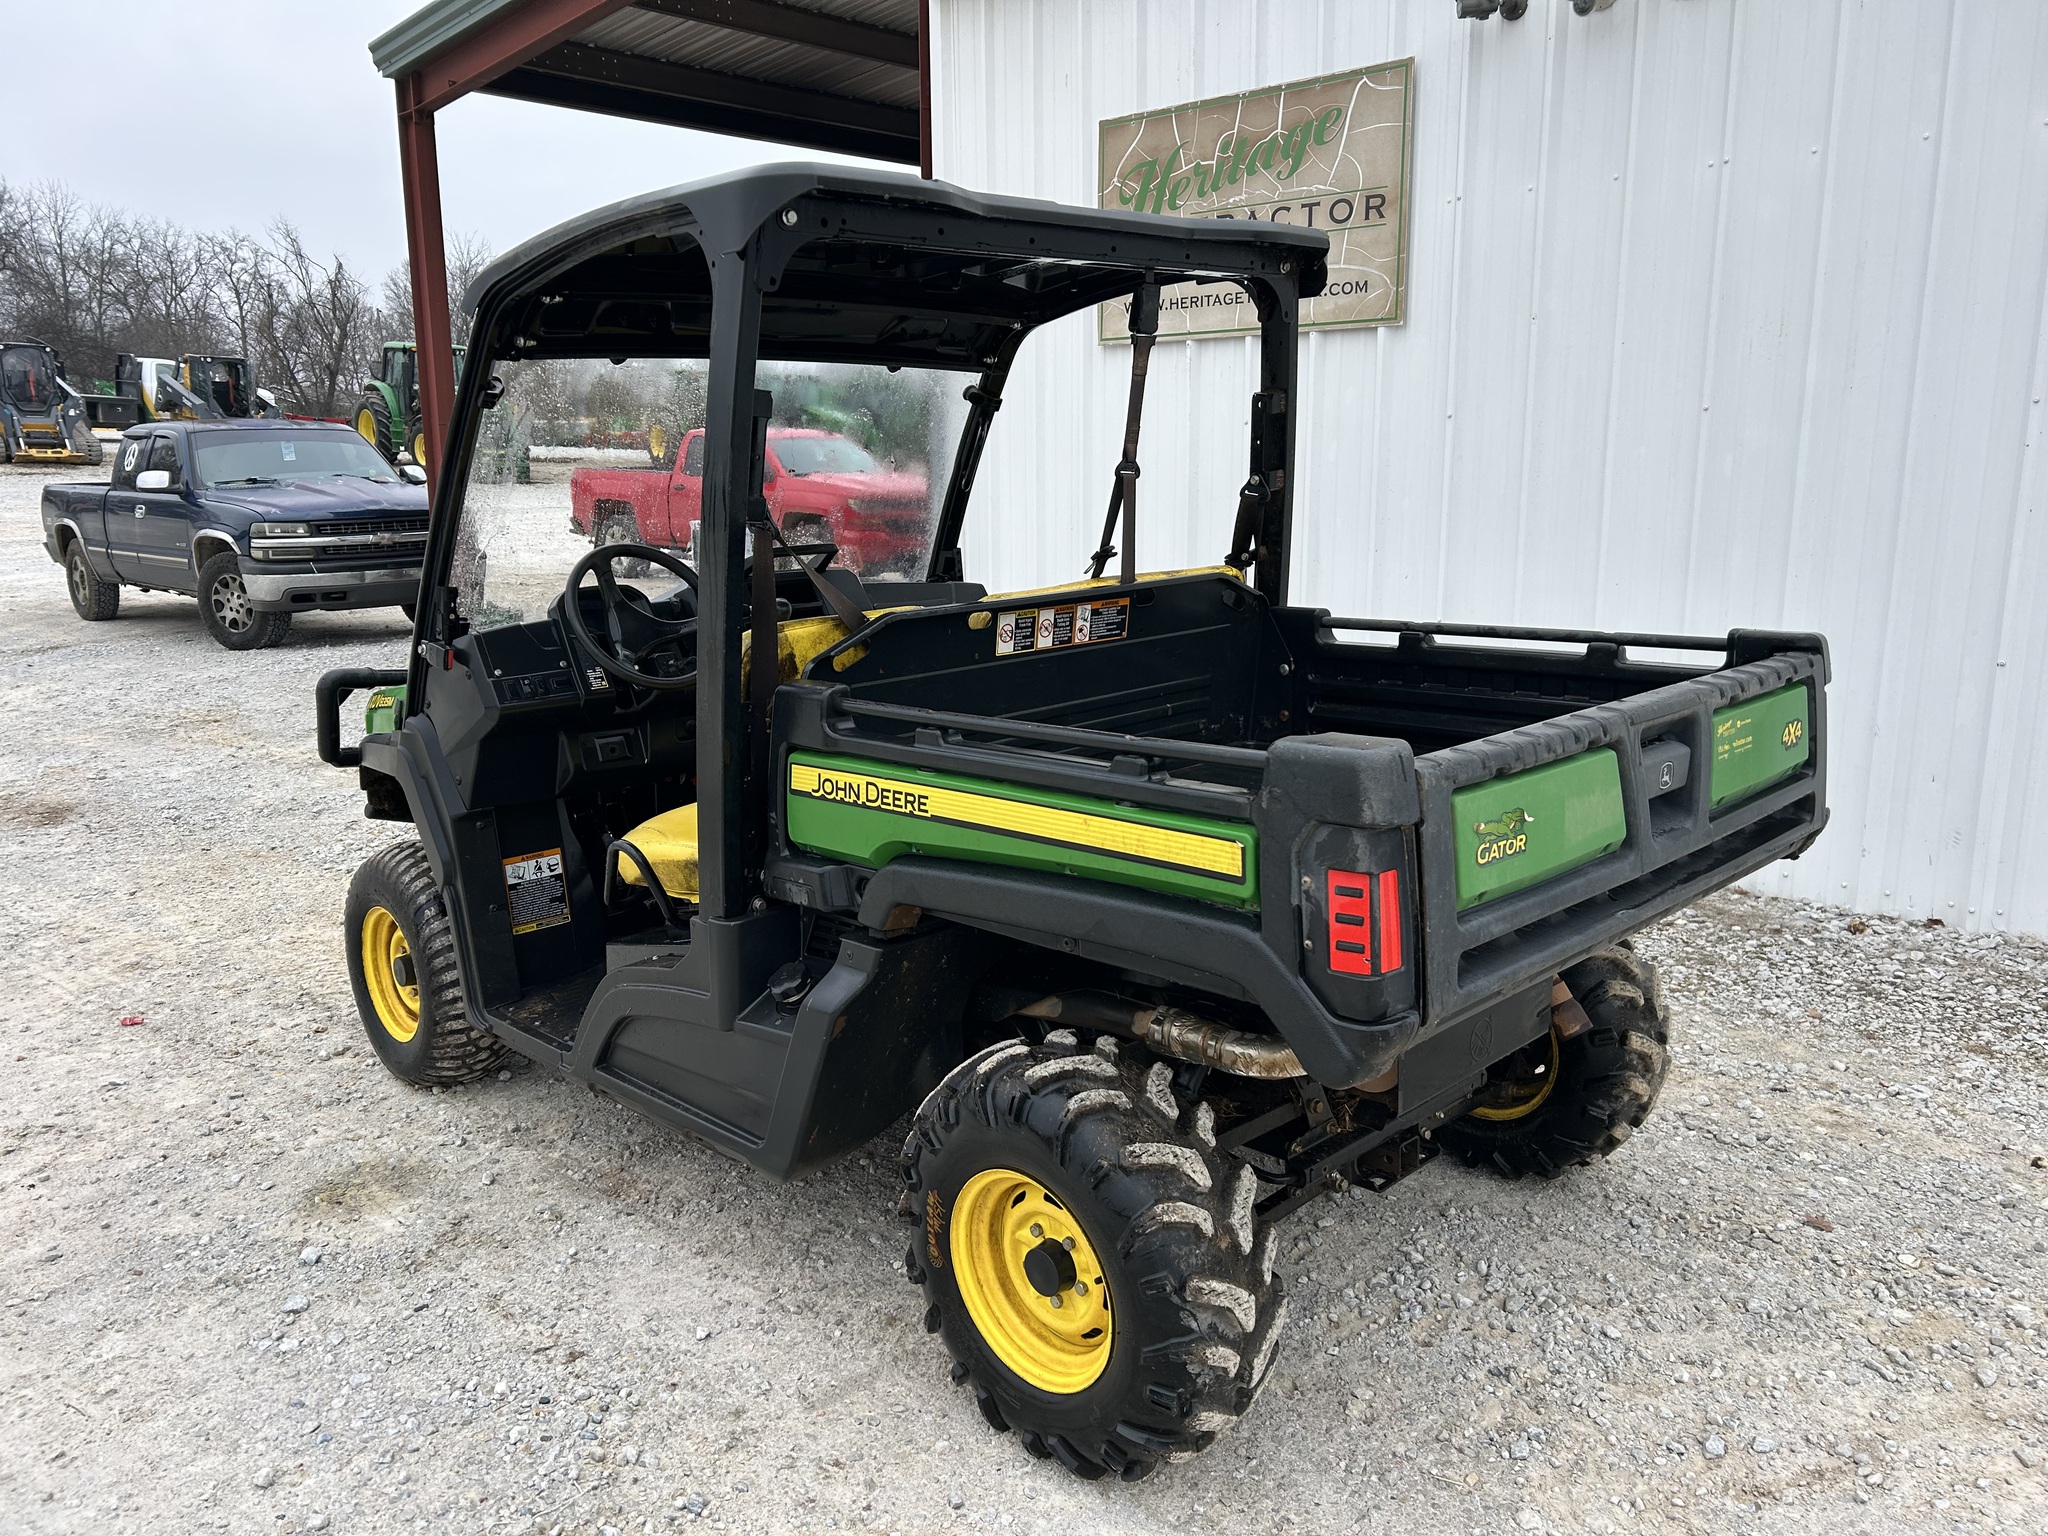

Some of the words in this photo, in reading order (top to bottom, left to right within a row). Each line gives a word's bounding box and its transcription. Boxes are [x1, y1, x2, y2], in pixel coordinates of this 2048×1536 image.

[1118, 106, 1343, 214] Heritage
[1203, 193, 1387, 228] CTOR
[811, 773, 861, 802] JOHN
[865, 781, 929, 814] DEERE
[1476, 833, 1528, 865] GATOR
[518, 925, 535, 933] CAUTION
